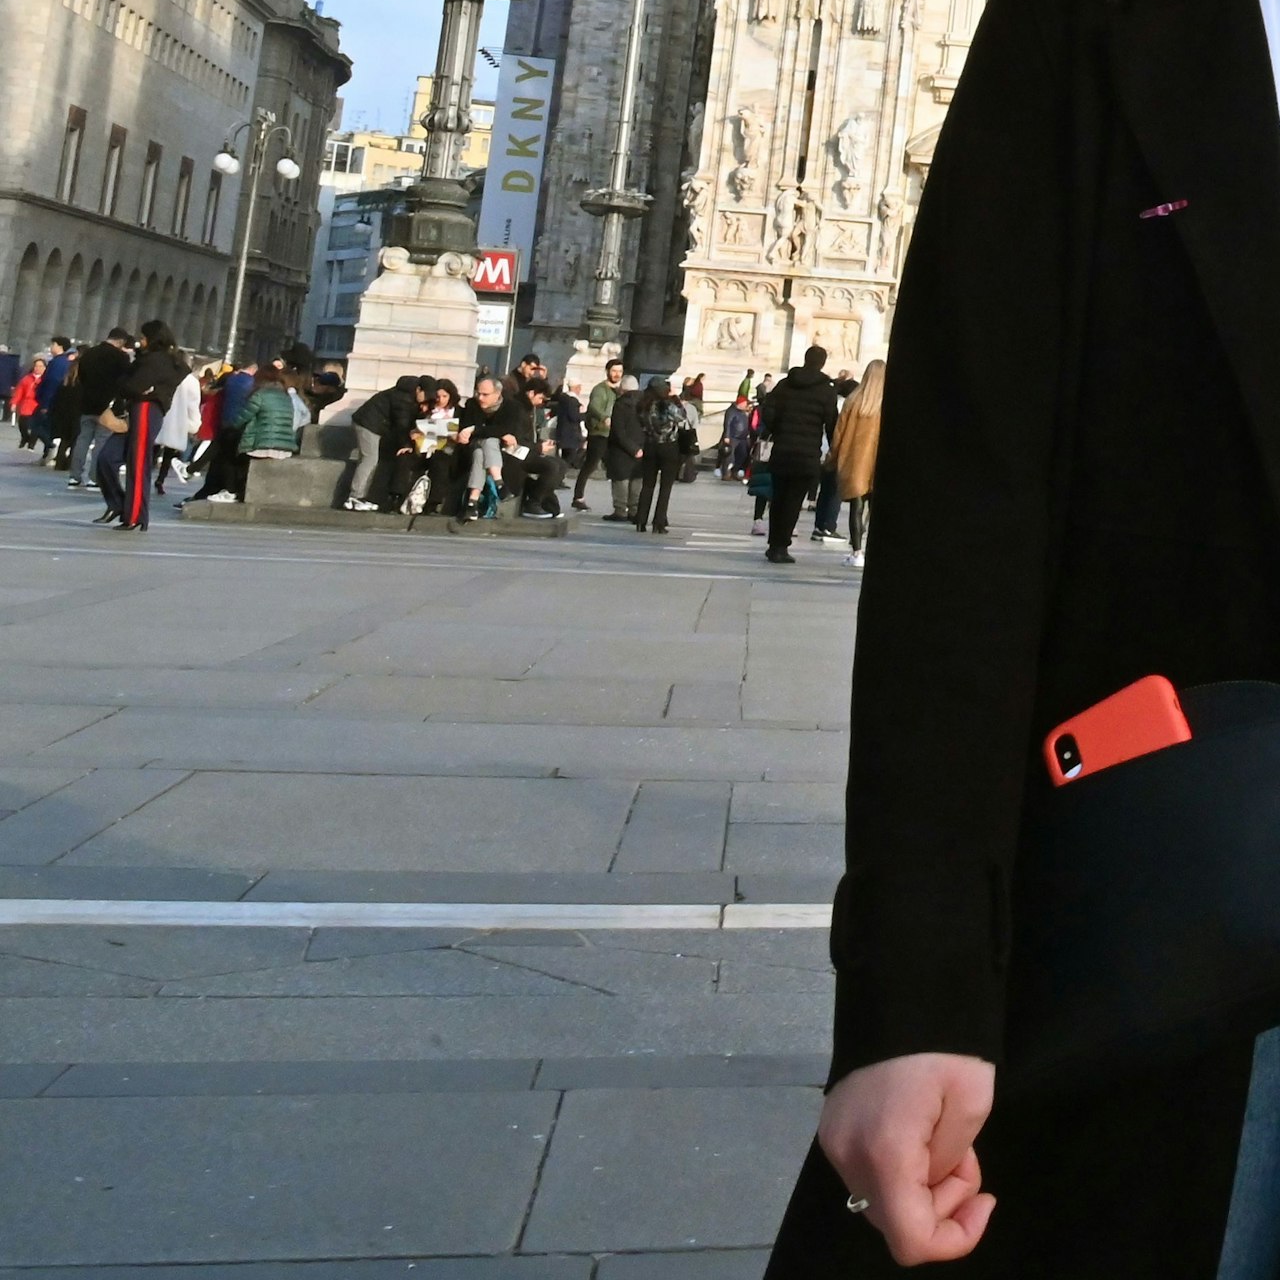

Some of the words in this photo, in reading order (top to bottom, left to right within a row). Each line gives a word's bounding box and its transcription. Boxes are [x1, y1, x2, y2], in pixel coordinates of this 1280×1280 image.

[501, 58, 549, 194] DKNY
[502, 218, 512, 248] ALLING
[474, 256, 511, 285] M
